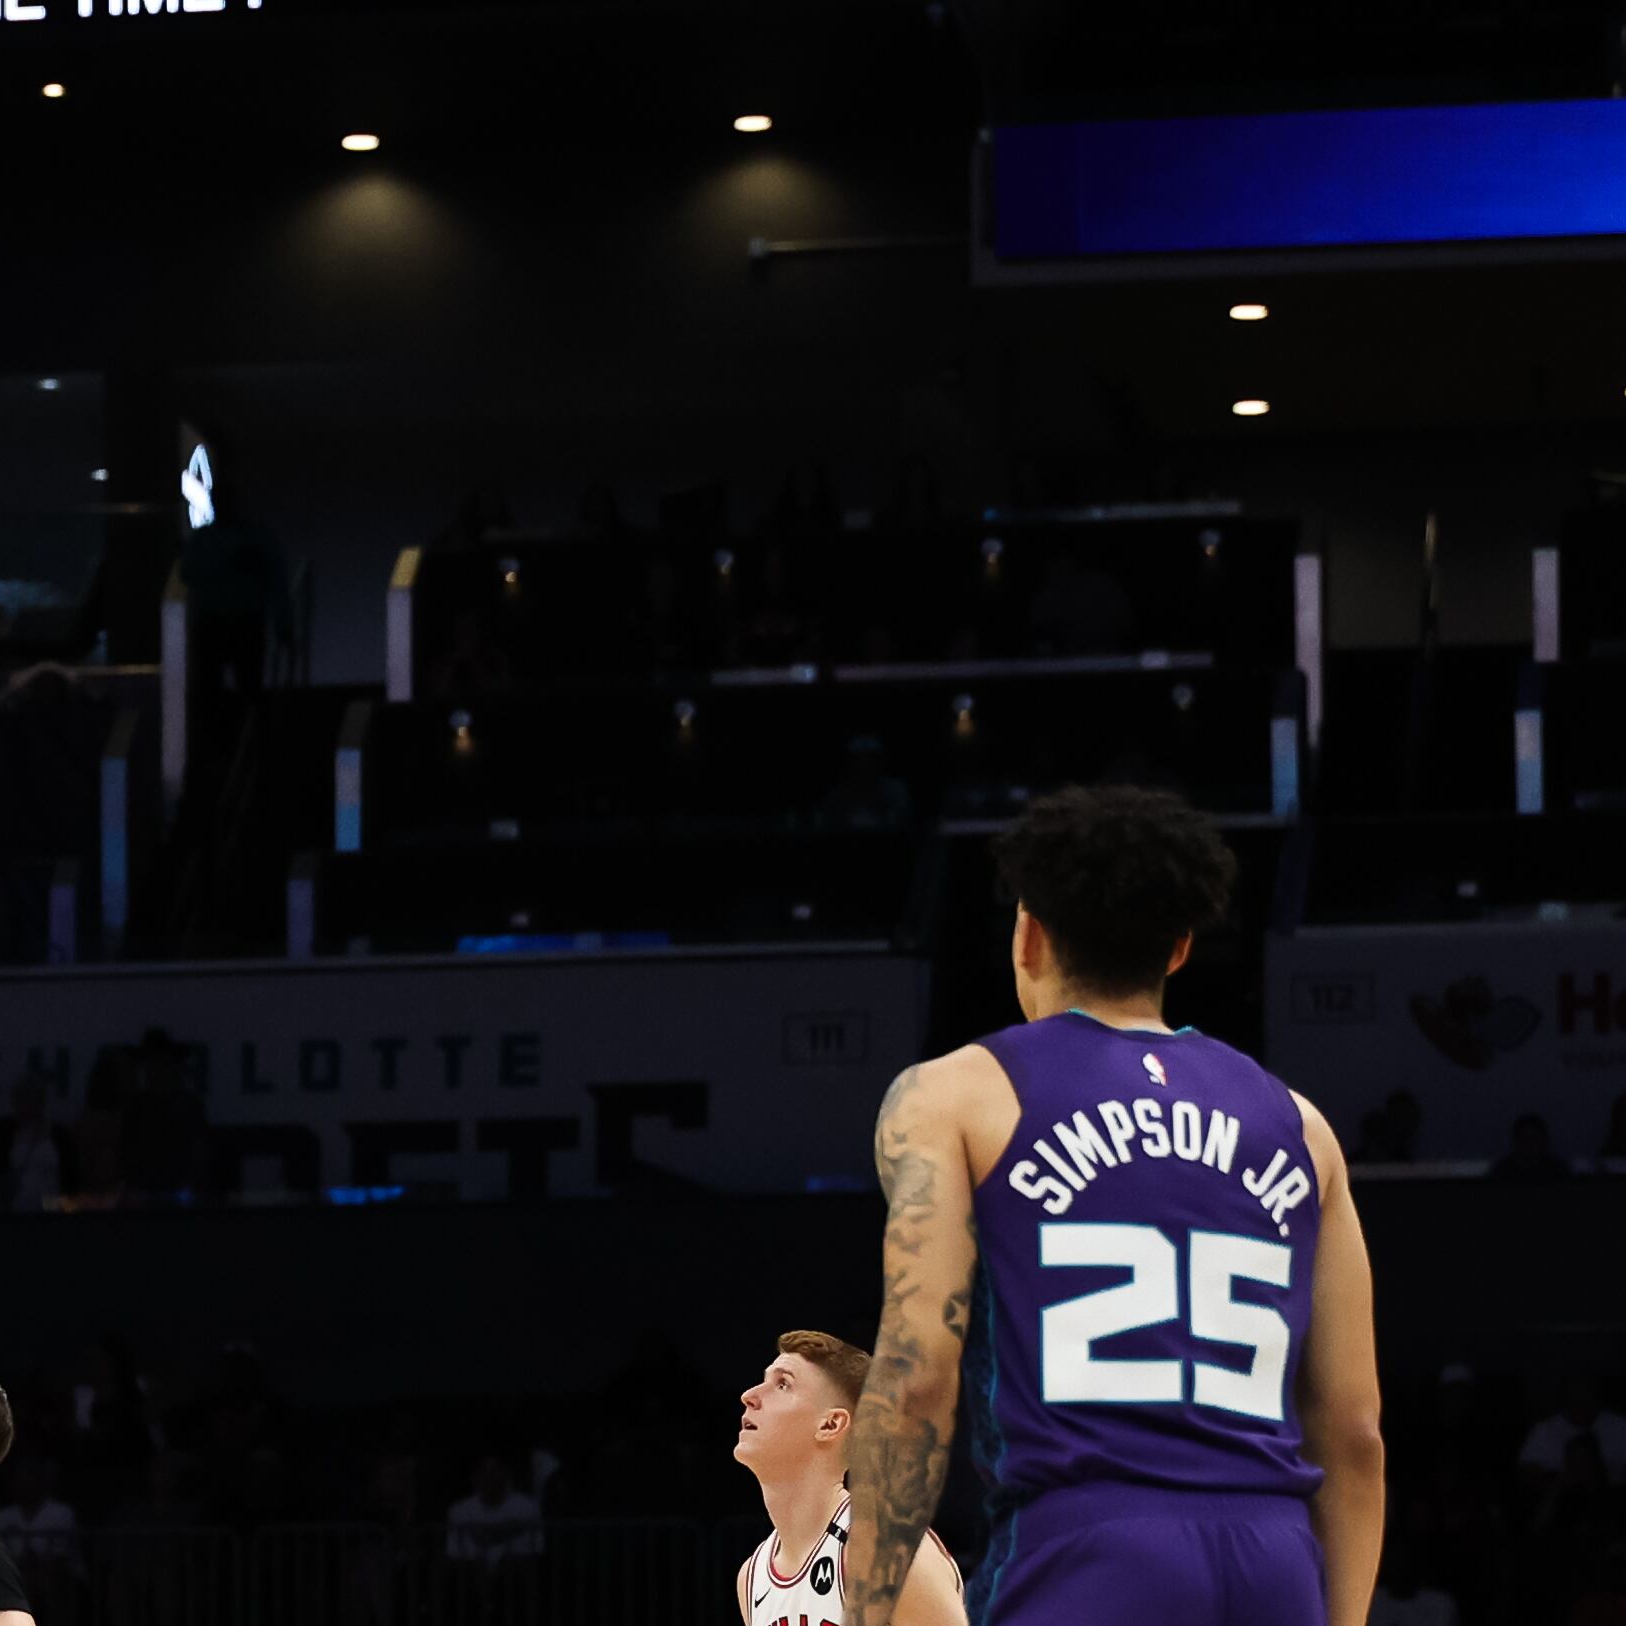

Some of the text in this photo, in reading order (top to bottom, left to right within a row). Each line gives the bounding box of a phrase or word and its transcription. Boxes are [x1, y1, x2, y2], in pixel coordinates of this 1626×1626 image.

[1008, 1098, 1311, 1238] SIMPSON JR.
[1039, 1220, 1294, 1423] 25
